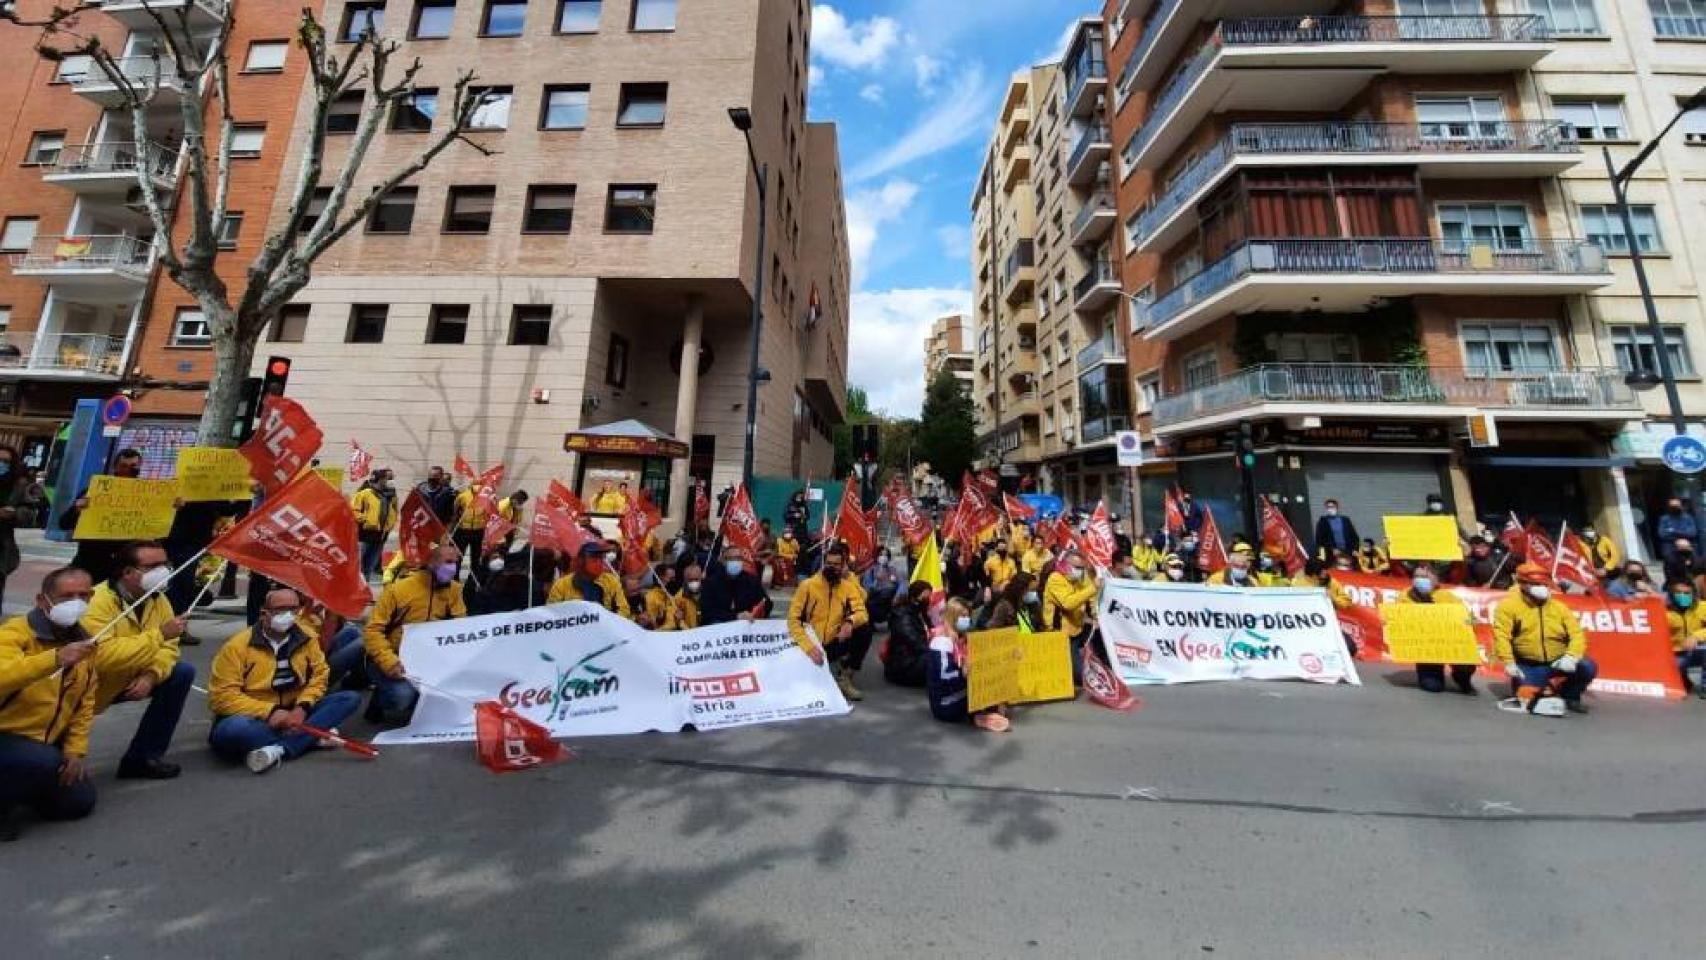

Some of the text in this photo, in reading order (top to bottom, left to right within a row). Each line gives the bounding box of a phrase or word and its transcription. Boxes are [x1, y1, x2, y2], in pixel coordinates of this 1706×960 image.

[435, 612, 600, 646] TASAS DE REPOSICIÓN
[1138, 610, 1160, 626] UN
[1165, 609, 1256, 629] CONVENIO
[1263, 611, 1327, 630] DIGNO
[681, 642, 700, 652] NO
[703, 640, 714, 650] A
[716, 634, 741, 647] LOS
[1157, 639, 1178, 657] EN
[676, 647, 738, 666] CAMPAÑA
